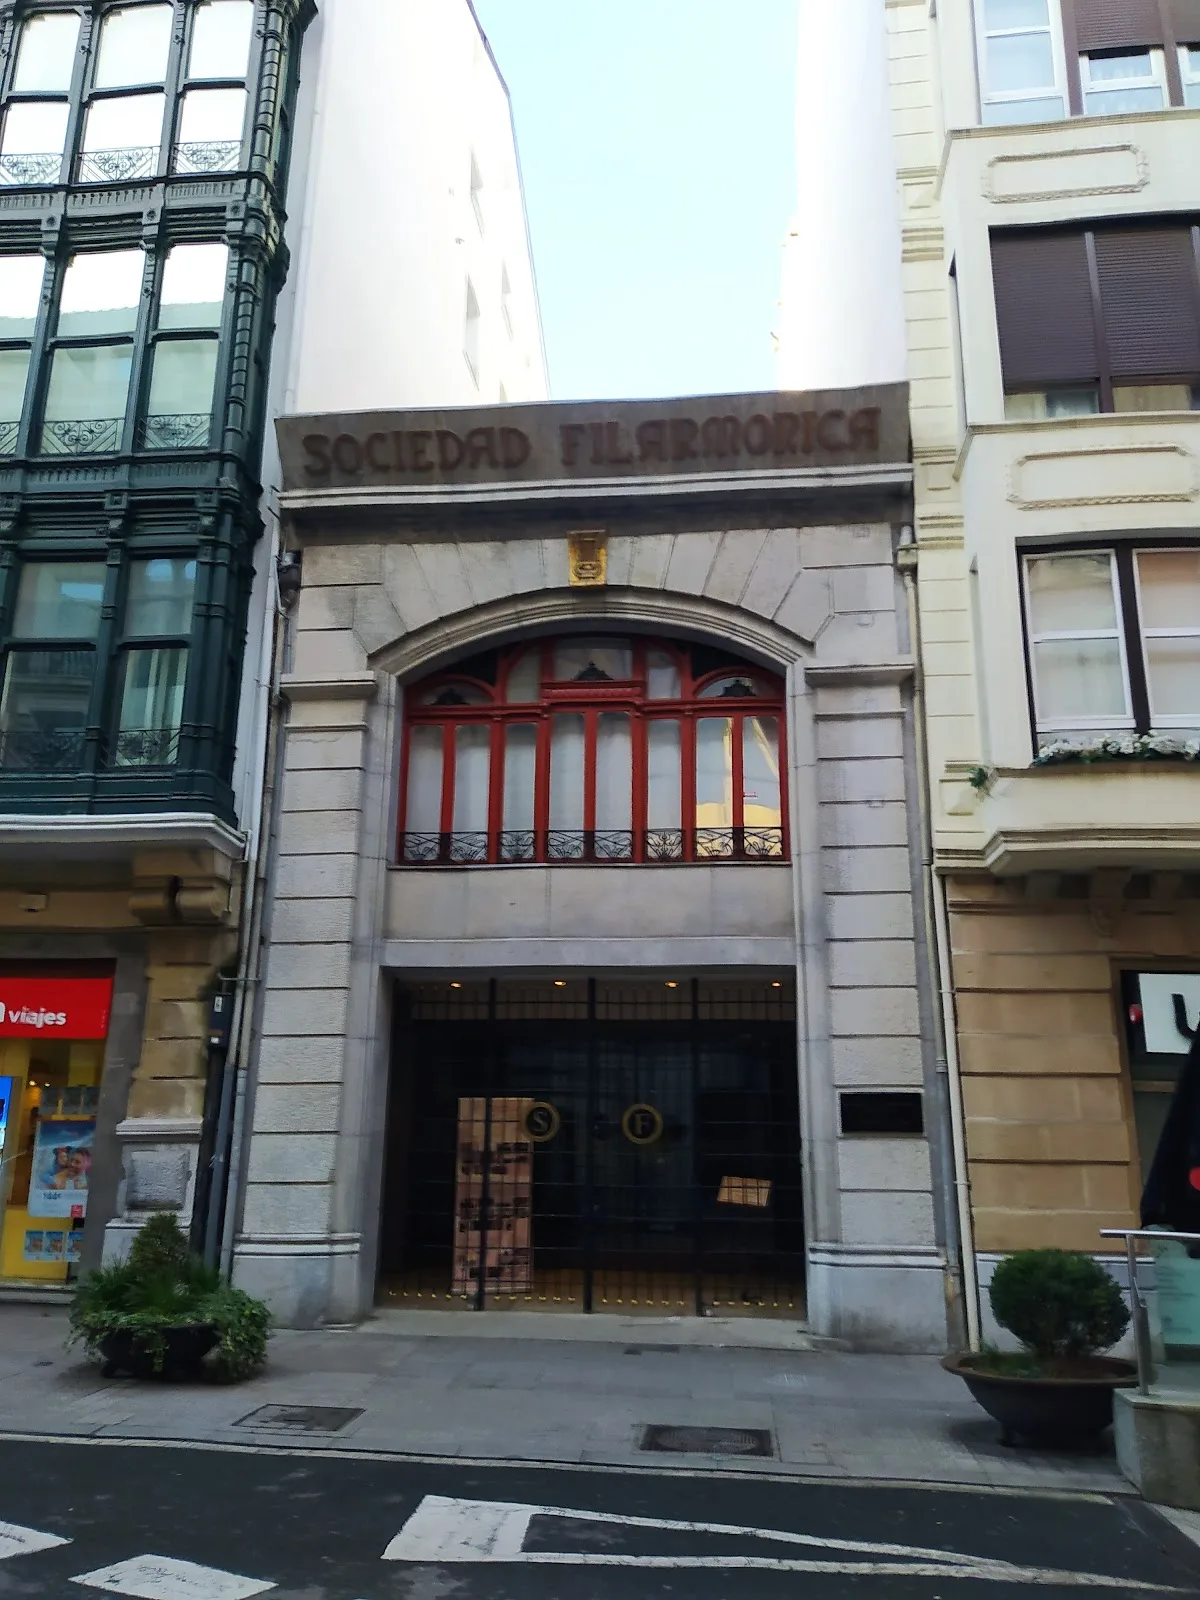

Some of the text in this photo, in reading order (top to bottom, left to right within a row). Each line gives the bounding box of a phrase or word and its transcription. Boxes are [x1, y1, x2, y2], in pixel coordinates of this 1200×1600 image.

[302, 426, 532, 476] SOCIEDAD
[9, 1006, 67, 1028] viajes
[532, 1109, 548, 1132] S
[634, 1112, 651, 1135] F
